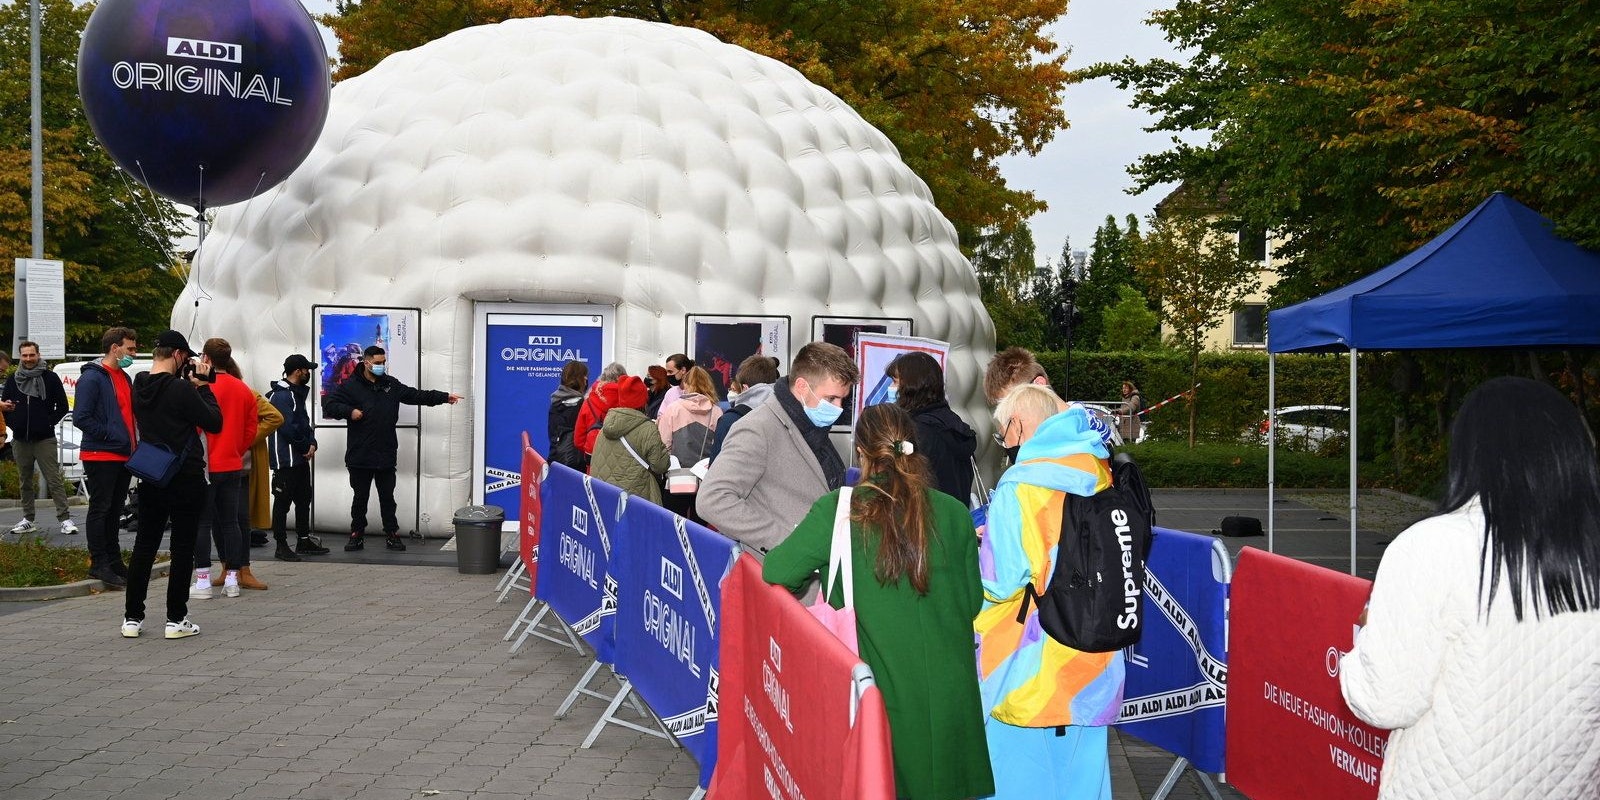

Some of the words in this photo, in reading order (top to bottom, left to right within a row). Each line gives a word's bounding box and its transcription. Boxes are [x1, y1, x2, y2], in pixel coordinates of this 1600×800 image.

[175, 40, 236, 60] ALDI
[112, 61, 293, 106] ORIGINAL
[501, 347, 588, 362] ORIGINAL
[531, 336, 559, 345] ALDI
[488, 469, 505, 477] ALDI
[488, 482, 505, 491] ALDI
[560, 531, 598, 590] ORIGINAL
[663, 562, 681, 595] ALDI
[1111, 508, 1140, 630] Supreme
[643, 589, 700, 679] ORIGINAL
[1163, 599, 1186, 629] ALDI
[1201, 657, 1227, 684] ALD
[1141, 699, 1162, 714] ALDI
[1165, 695, 1187, 710] ALDI
[1205, 687, 1225, 701] AL
[1264, 681, 1278, 704] DIE
[1279, 690, 1302, 716] NEUE
[1303, 701, 1389, 759] FASHION-KOLLEK
[1329, 744, 1377, 787] VERKAUF
